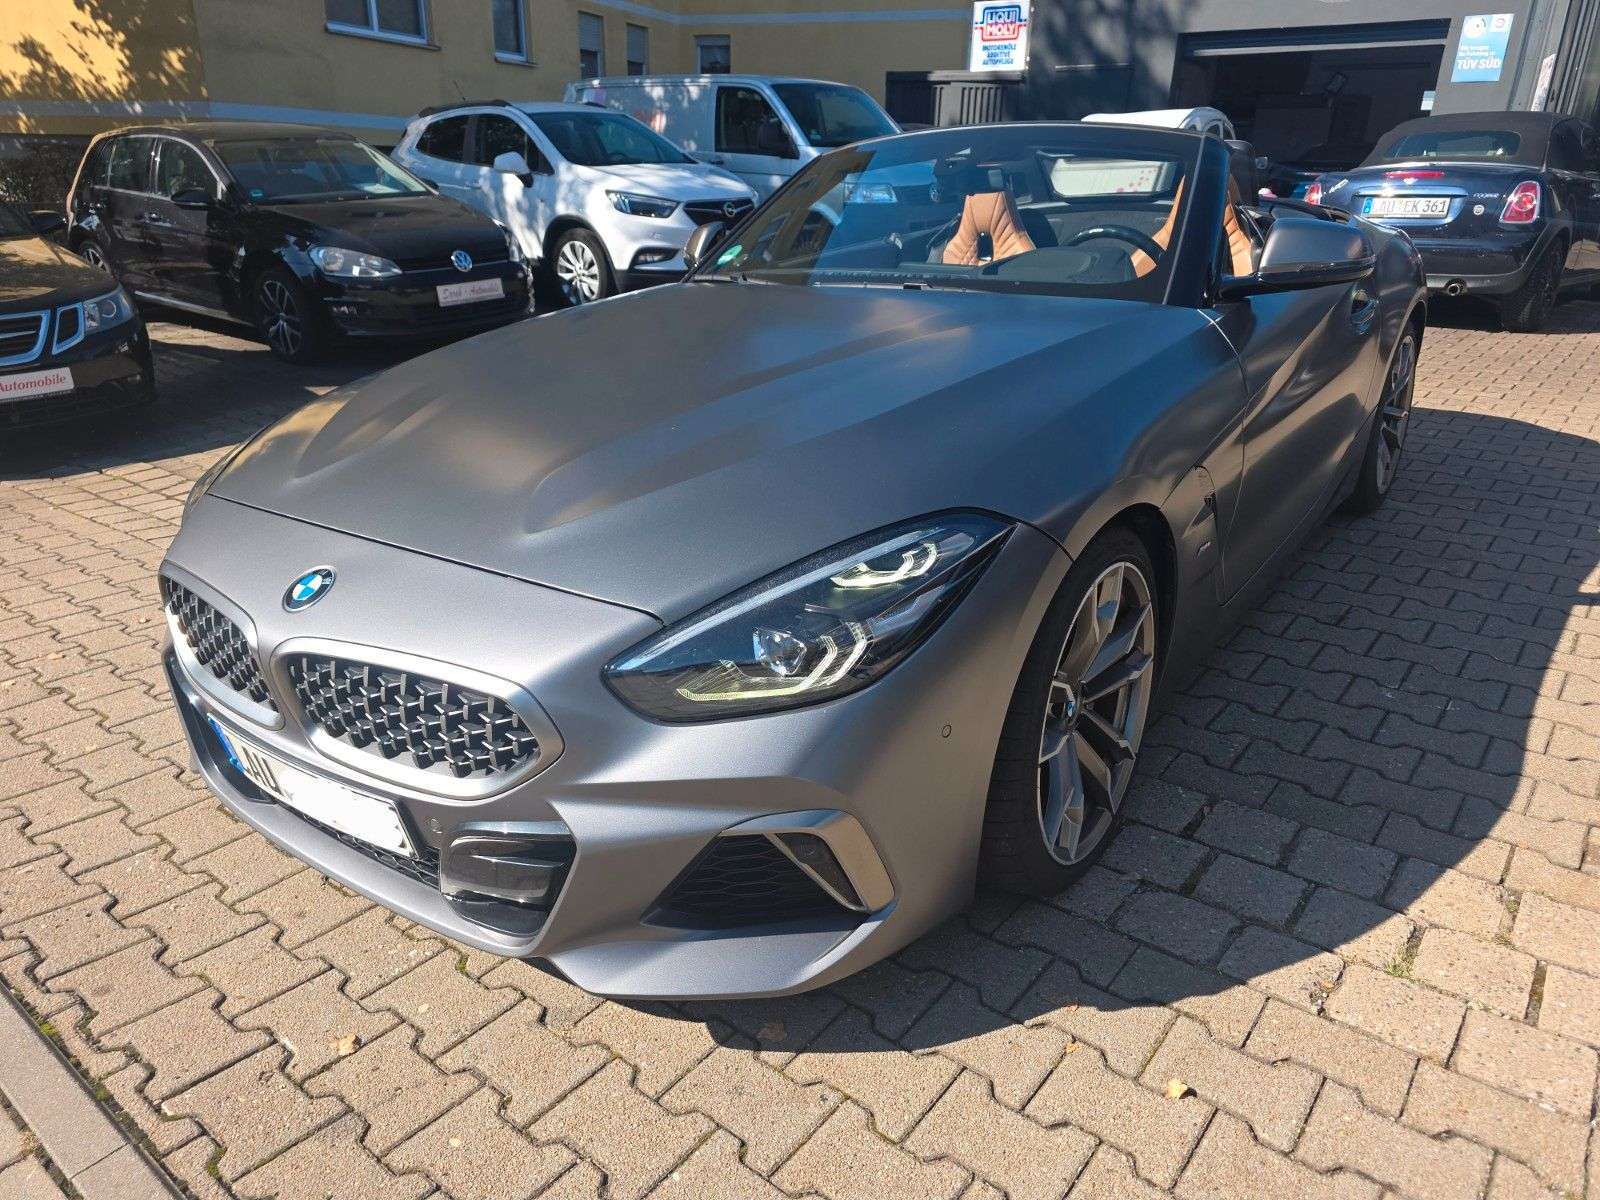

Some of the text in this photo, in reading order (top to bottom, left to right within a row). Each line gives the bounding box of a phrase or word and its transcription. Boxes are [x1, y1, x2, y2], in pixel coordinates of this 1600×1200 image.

[986, 10, 1016, 23] LIQUI
[986, 23, 1015, 36] MOLY
[1456, 56, 1500, 69] TÜV SÜD
[1422, 200, 1446, 213] 361
